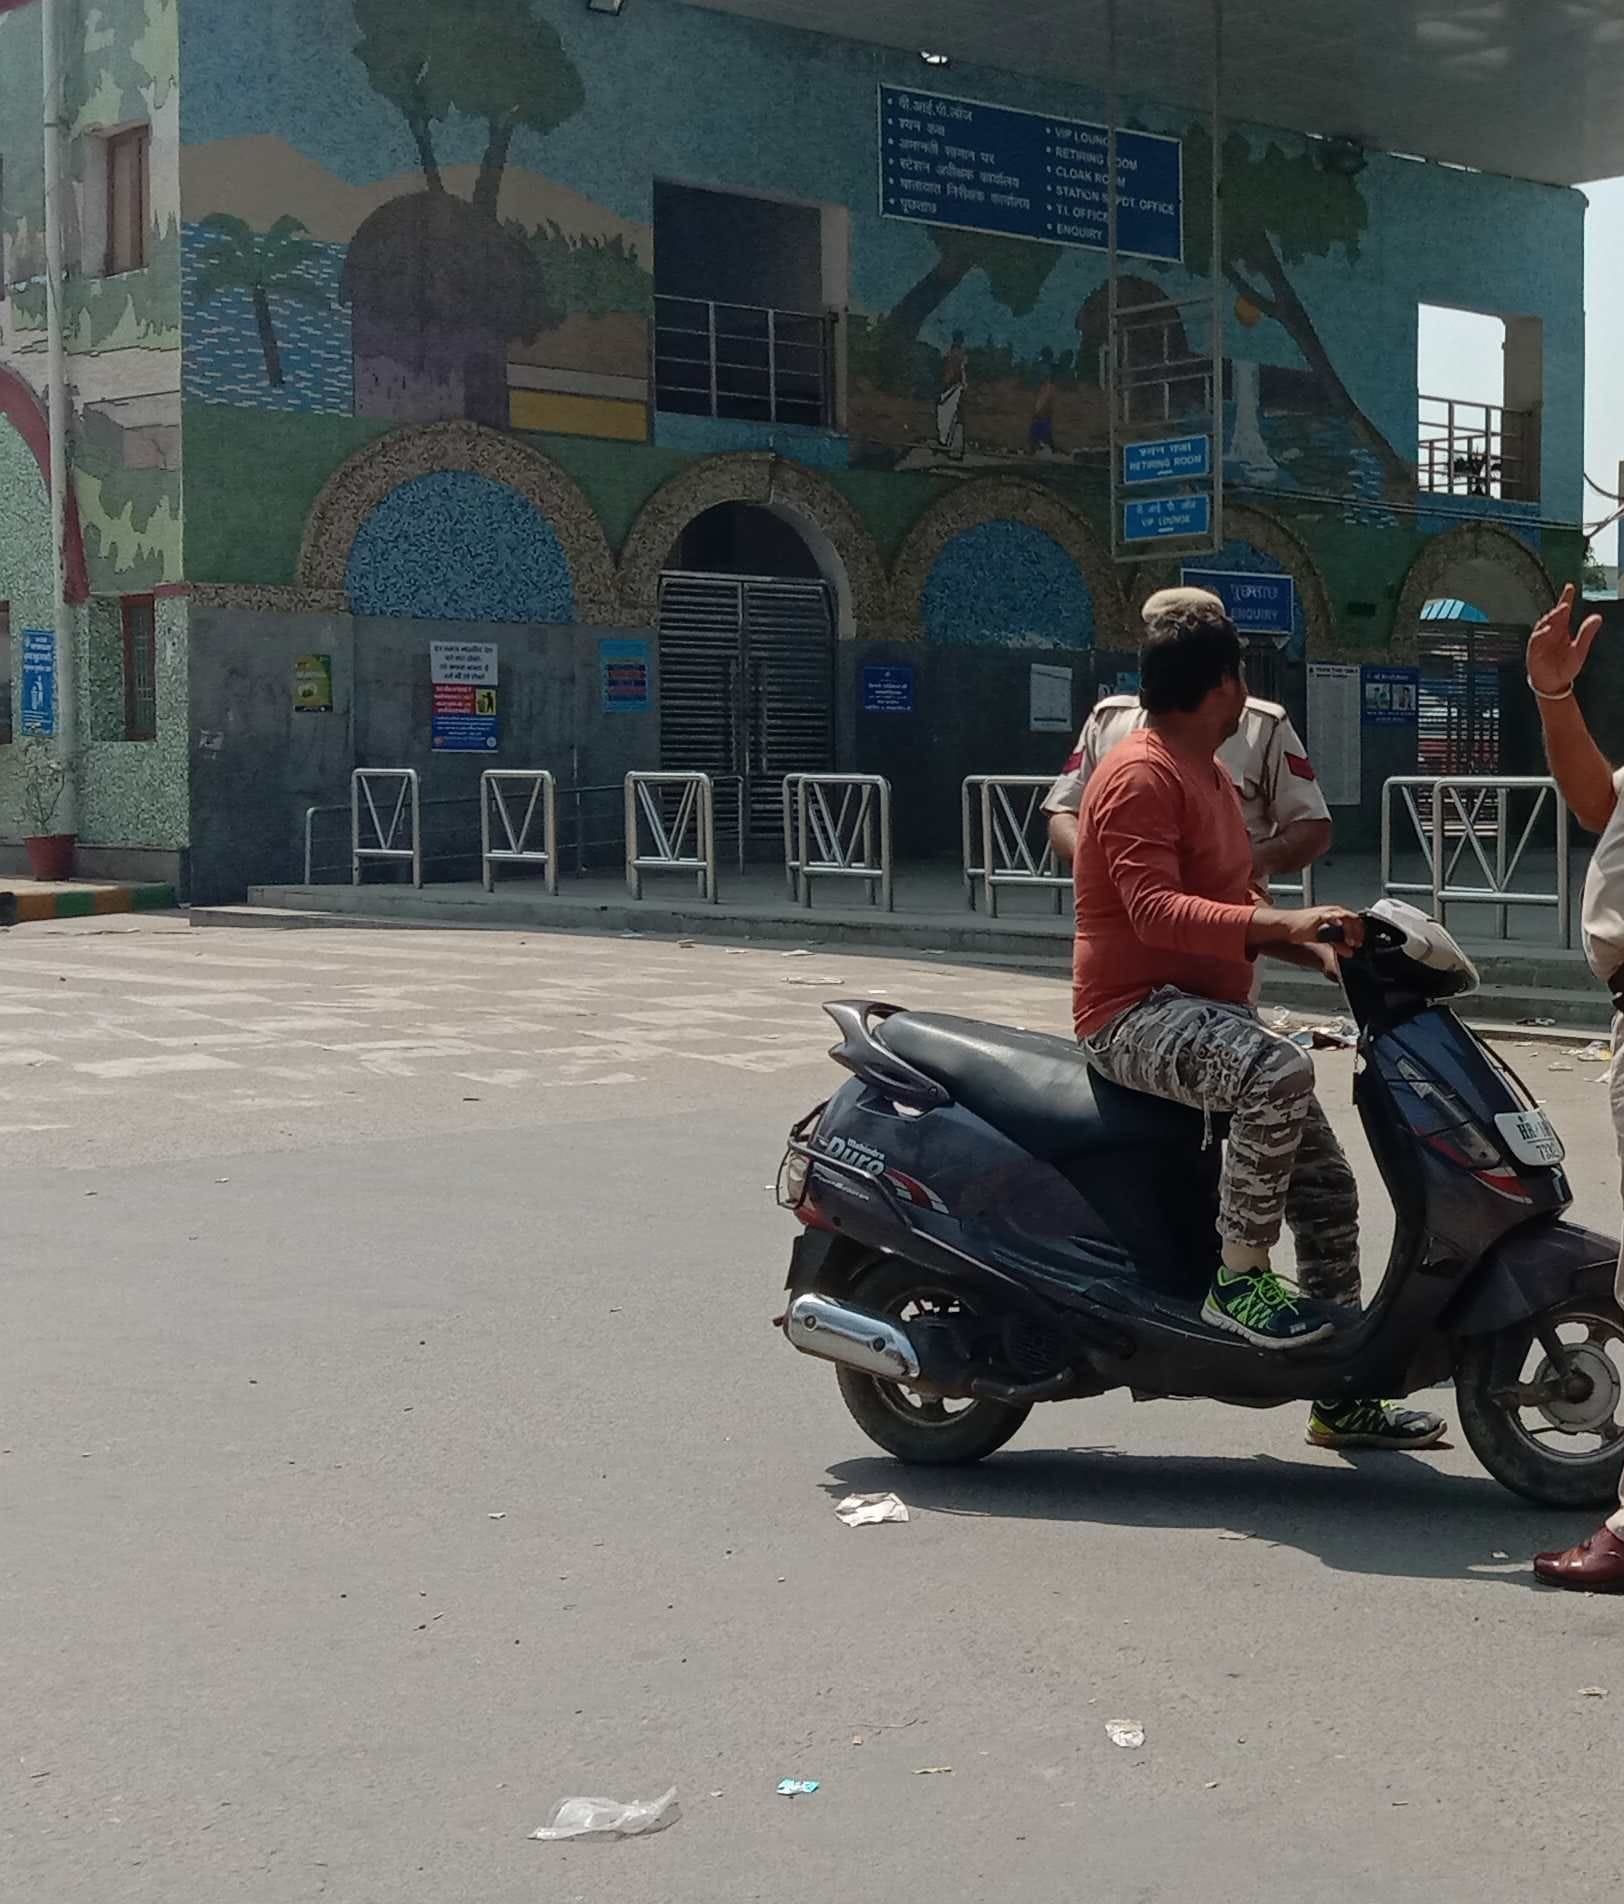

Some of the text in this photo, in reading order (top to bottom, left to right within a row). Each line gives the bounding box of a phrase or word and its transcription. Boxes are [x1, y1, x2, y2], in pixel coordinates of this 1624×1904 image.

[1055, 127, 1109, 146] VIP LOUNG
[1055, 146, 1104, 165] RETIRING
[1055, 166, 1126, 187] CLOAK ROM
[1055, 186, 1099, 201] STATION
[1139, 199, 1175, 216] OFFICE
[1056, 224, 1103, 240] ENQUIRY
[1129, 454, 1202, 472] RETIRING ROOM
[1231, 607, 1280, 622] ENQUIRY
[825, 1135, 886, 1176] Duro
